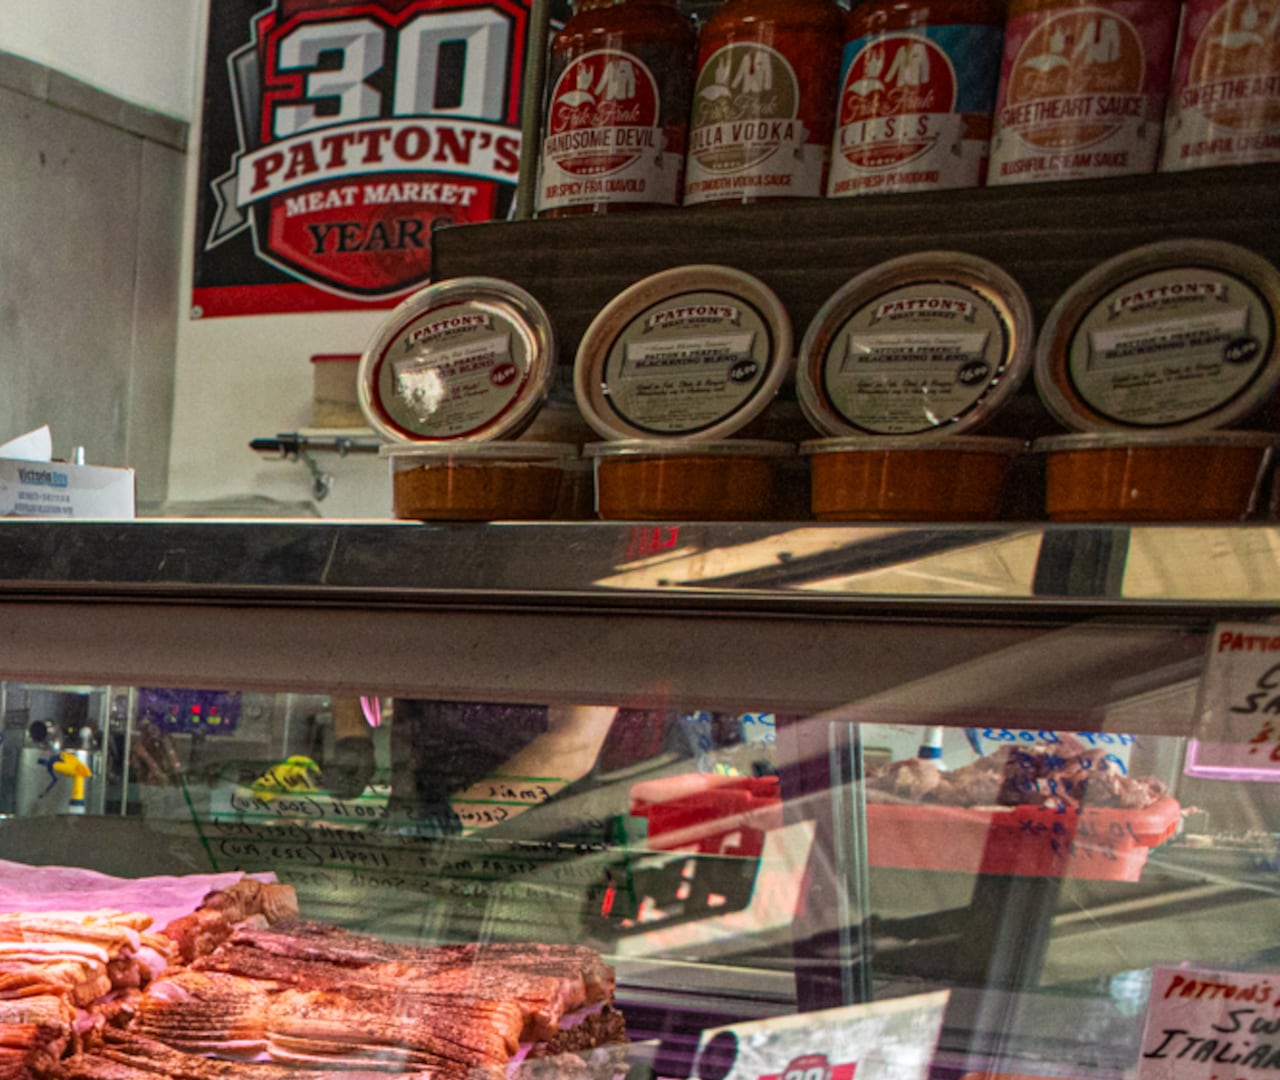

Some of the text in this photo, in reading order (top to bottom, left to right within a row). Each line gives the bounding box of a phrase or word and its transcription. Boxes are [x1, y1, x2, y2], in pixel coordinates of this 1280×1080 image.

[273, 8, 512, 140] 30
[1000, 94, 1142, 129] SWEETHEART SAUCE
[614, 126, 655, 149] DEVIL
[732, 121, 795, 142] VODKA
[249, 125, 521, 194] PATTON'S
[1093, 151, 1129, 167] SAUCE
[732, 176, 763, 190] VODKA
[764, 174, 793, 187] SAUCE
[284, 183, 477, 218] MEAT MARKET
[1120, 284, 1215, 306] PATTON'S
[654, 306, 733, 324] PATTON'S
[883, 299, 967, 314] PATTON'S
[413, 315, 485, 341] PATTON'S
[491, 367, 517, 386] $6.99
[730, 363, 757, 381] $6.99
[1164, 975, 1276, 1003] PATTON'S
